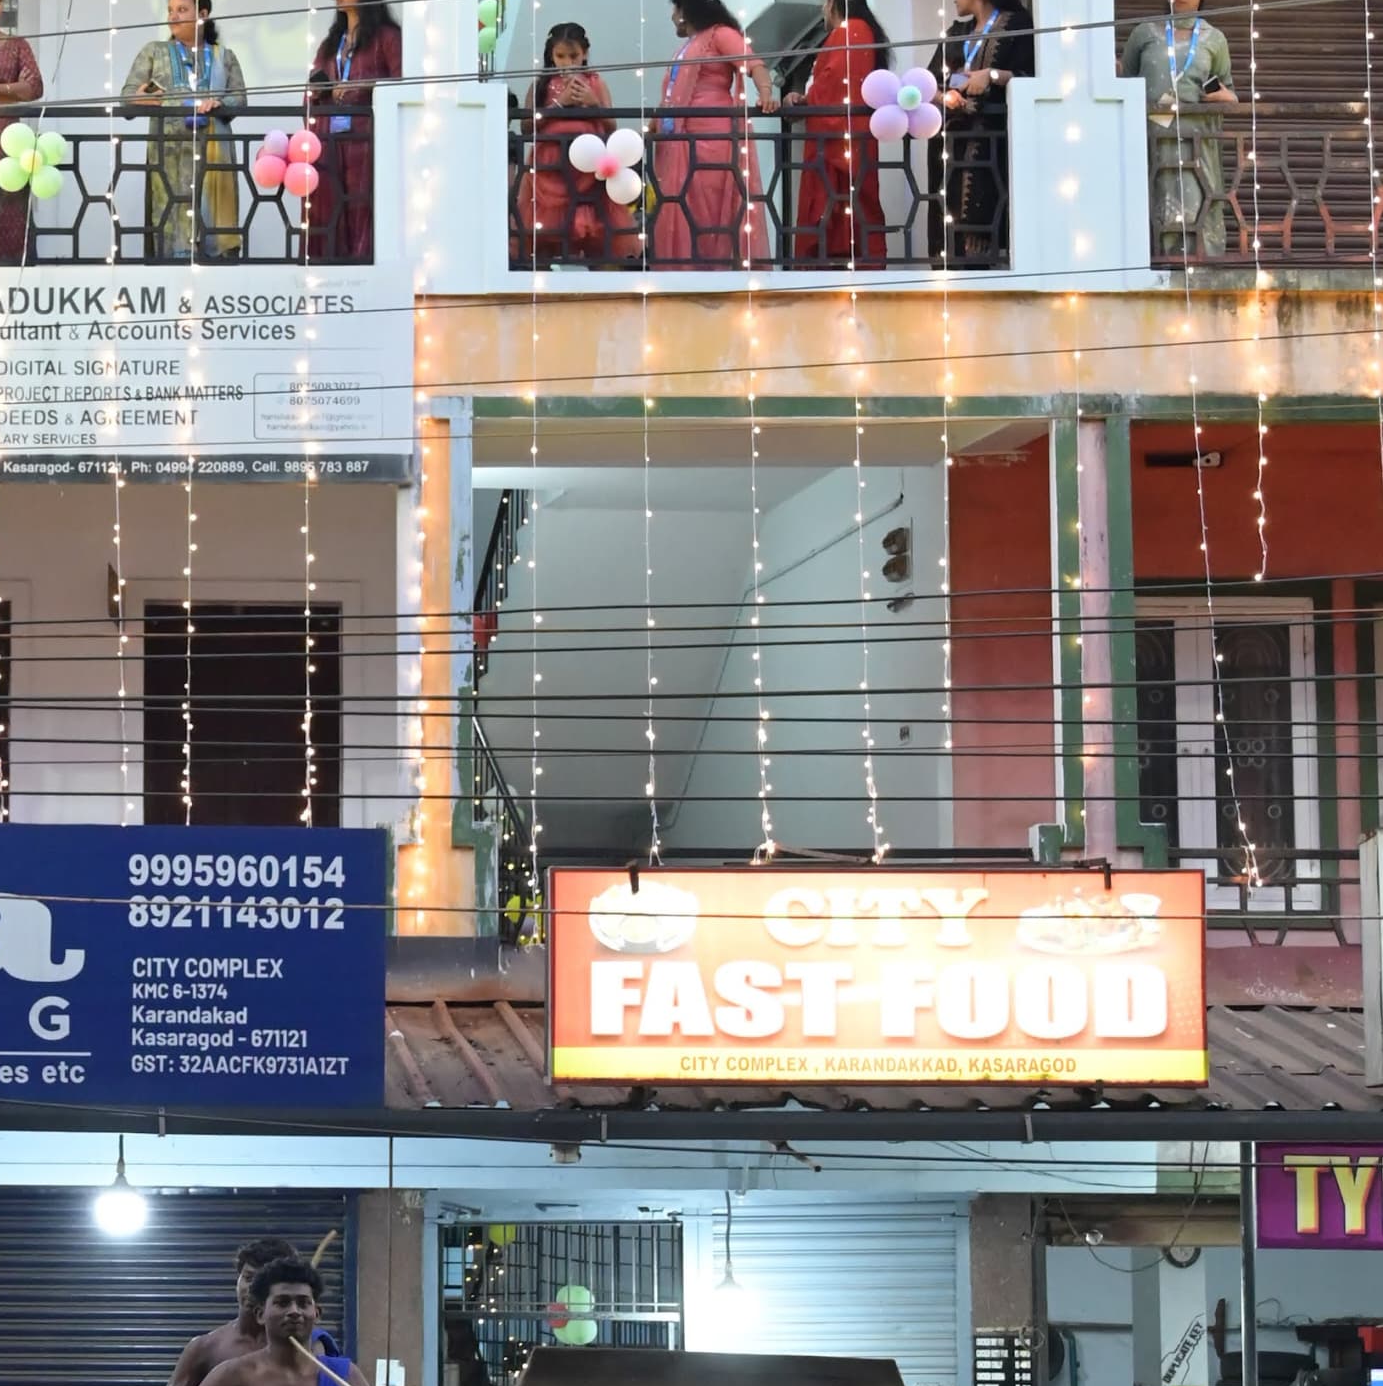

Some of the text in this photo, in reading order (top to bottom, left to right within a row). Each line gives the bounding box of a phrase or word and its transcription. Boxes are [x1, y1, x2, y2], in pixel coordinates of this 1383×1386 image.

[178, 298, 192, 315] &
[204, 295, 355, 315] ASSOCIATES
[69, 326, 80, 341] &
[87, 321, 193, 341] Accounts
[201, 319, 297, 341] Services
[74, 360, 181, 376] SIGNATURE
[146, 384, 181, 401] BANK
[185, 384, 244, 401] MATTERS
[33, 433, 97, 445] SERVICES
[131, 460, 153, 473] Ph:
[319, 460, 342, 473] 783
[345, 460, 369, 473] 887
[128, 853, 346, 889] 9995960154
[128, 894, 345, 931] 8921143012
[763, 887, 989, 948] CITY
[132, 957, 284, 979] CITY COMPLEX
[132, 982, 228, 1000] KMC 6-1374
[588, 960, 1168, 1040] FAST FOOD
[131, 1004, 248, 1025] Karandakad
[131, 1028, 234, 1051] Kasaragod
[250, 1029, 308, 1048] 671121
[42, 1060, 86, 1085] etc
[131, 1054, 350, 1076] GST: 32AACFK9731A1ZT
[679, 1056, 1078, 1075] CITY COMPLEX KARANDAKKAD, KASARAGOD
[1189, 1321, 1203, 1340] KEY
